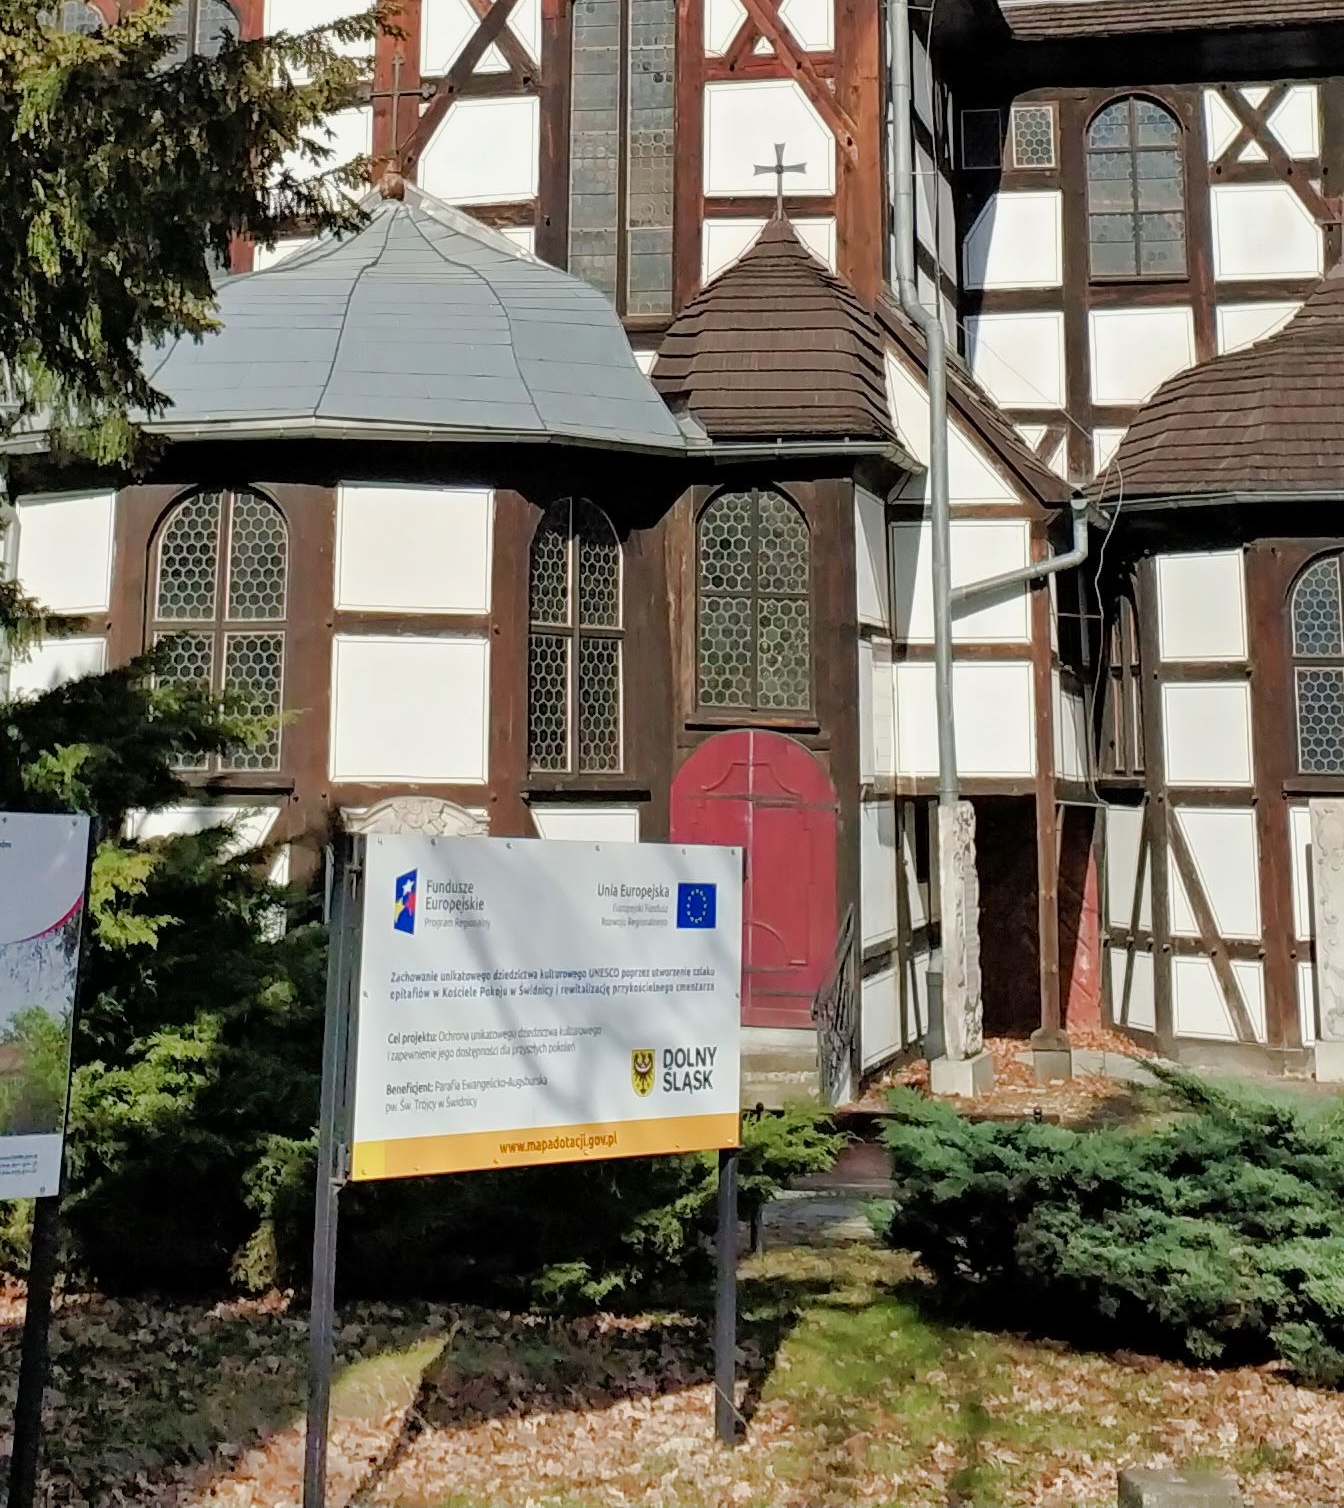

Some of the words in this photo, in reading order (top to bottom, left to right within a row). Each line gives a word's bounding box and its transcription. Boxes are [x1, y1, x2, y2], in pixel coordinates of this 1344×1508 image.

[426, 879, 474, 894] Fundusze
[598, 883, 618, 897] Unia
[621, 884, 669, 900] Europejska
[426, 896, 484, 914] Europejskie
[391, 971, 438, 983] Zachowanie
[441, 970, 491, 983] unikatowego
[493, 969, 538, 981] dziedzictwa
[540, 967, 587, 981] kulturowego
[588, 967, 619, 979] UNESCO
[390, 987, 430, 1001] epitafiów
[433, 990, 440, 998] w
[442, 985, 477, 999] Kościele
[479, 985, 507, 998] Pokoju
[510, 988, 516, 996] w
[519, 984, 554, 997] Świdnicy
[561, 983, 610, 996] rewitalizację
[388, 1032, 400, 1044] Cel
[663, 1046, 718, 1069] DOLNY
[662, 1067, 713, 1094] ŚLĄSK
[499, 1131, 618, 1154] www.mapadotacji.gov.pl
